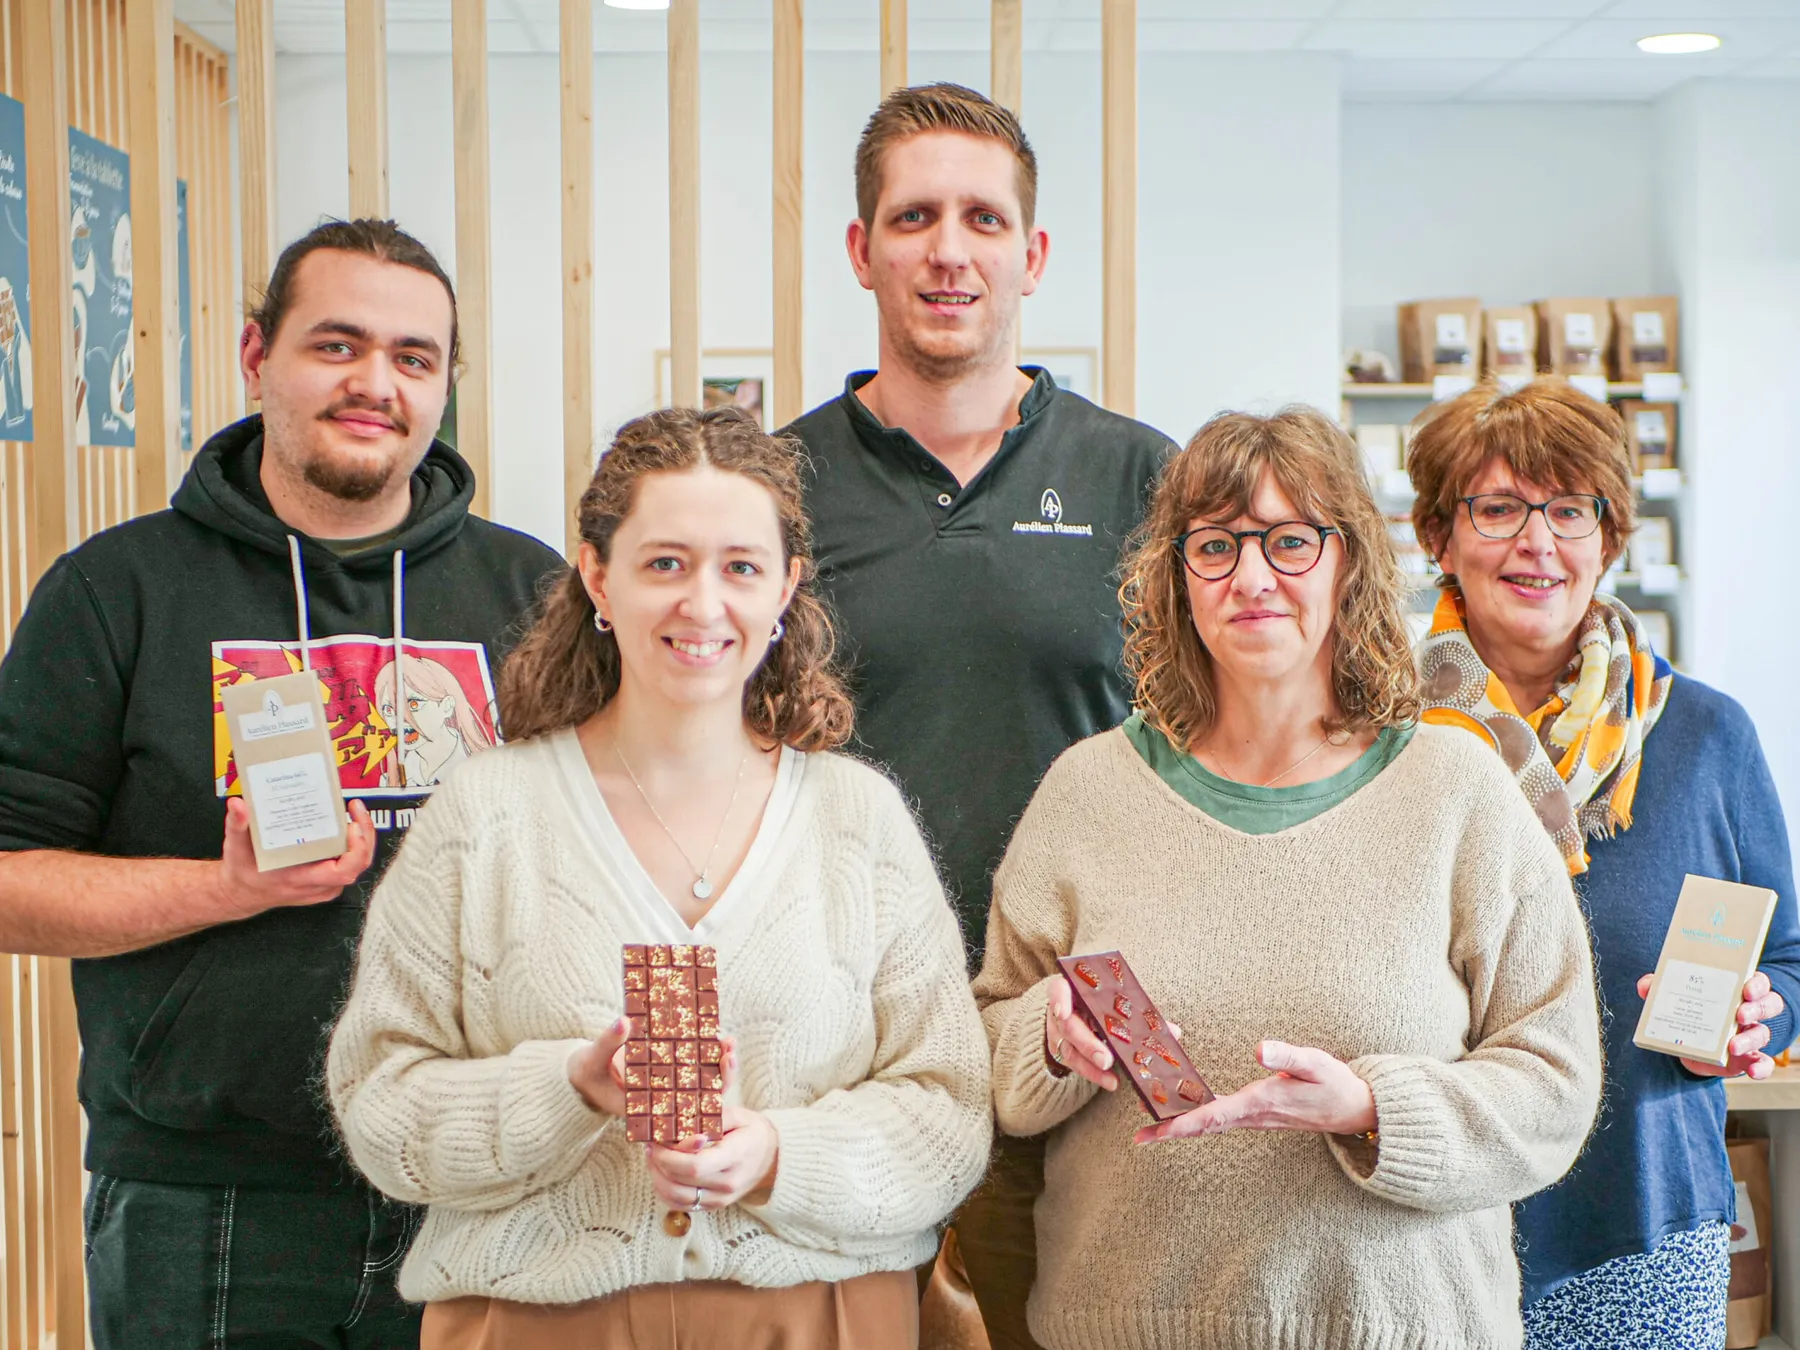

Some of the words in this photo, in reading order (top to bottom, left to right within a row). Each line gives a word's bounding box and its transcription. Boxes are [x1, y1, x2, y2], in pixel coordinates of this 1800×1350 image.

[1044, 496, 1059, 518] AP
[1012, 520, 1053, 533] Aurélien
[1054, 522, 1093, 536] Plassard
